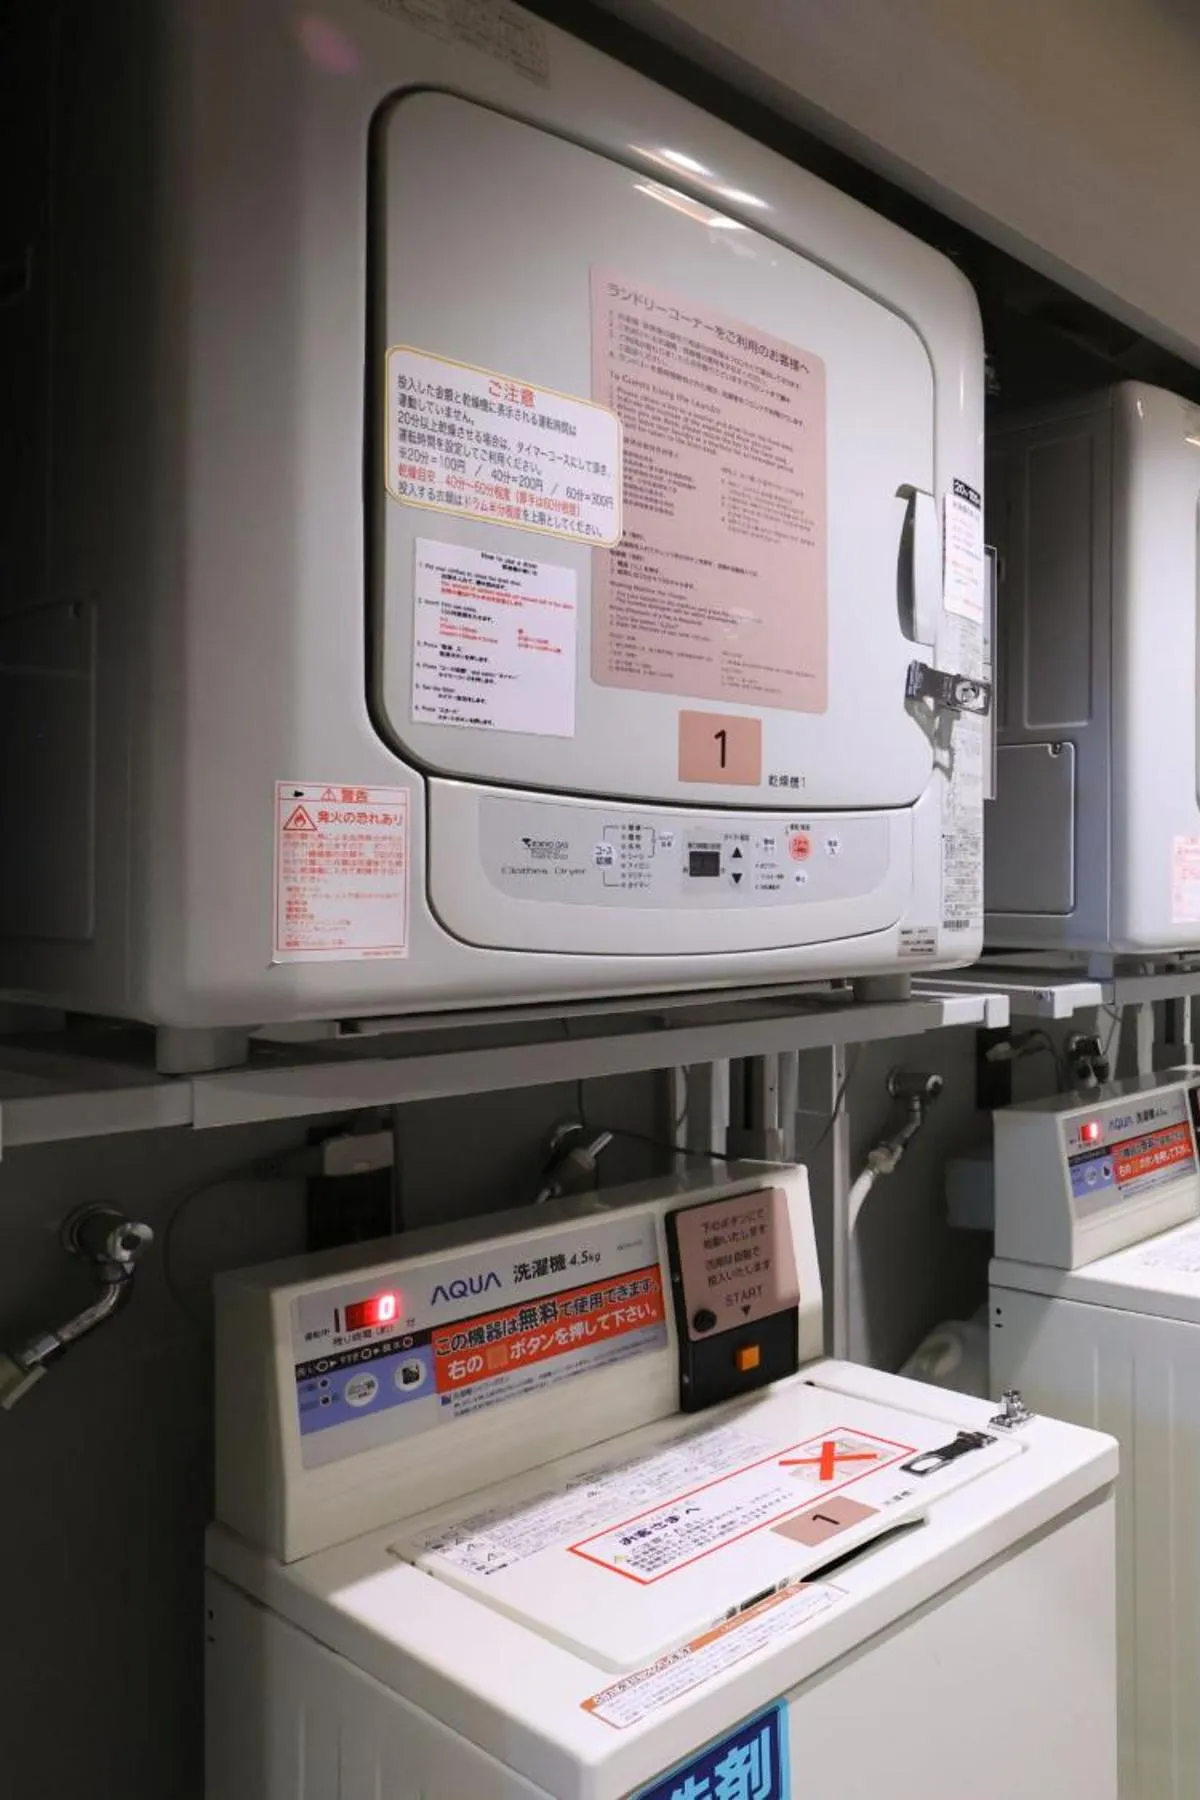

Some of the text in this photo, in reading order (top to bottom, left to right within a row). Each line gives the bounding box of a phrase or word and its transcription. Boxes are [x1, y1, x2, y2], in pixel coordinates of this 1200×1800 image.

[488, 379, 535, 408] ご注意
[714, 729, 727, 768] 1
[317, 811, 403, 827] 発火の恐れあり
[431, 1272, 501, 1306] AQUA
[513, 1254, 567, 1284] 洗濯機
[378, 1295, 396, 1321] 0
[725, 1284, 763, 1307] START
[435, 1278, 658, 1356] この機器は無料で使用できます。
[448, 1354, 484, 1381] 右の
[510, 1303, 658, 1360] ボタンを押して下さい。
[812, 1514, 840, 1526] 1
